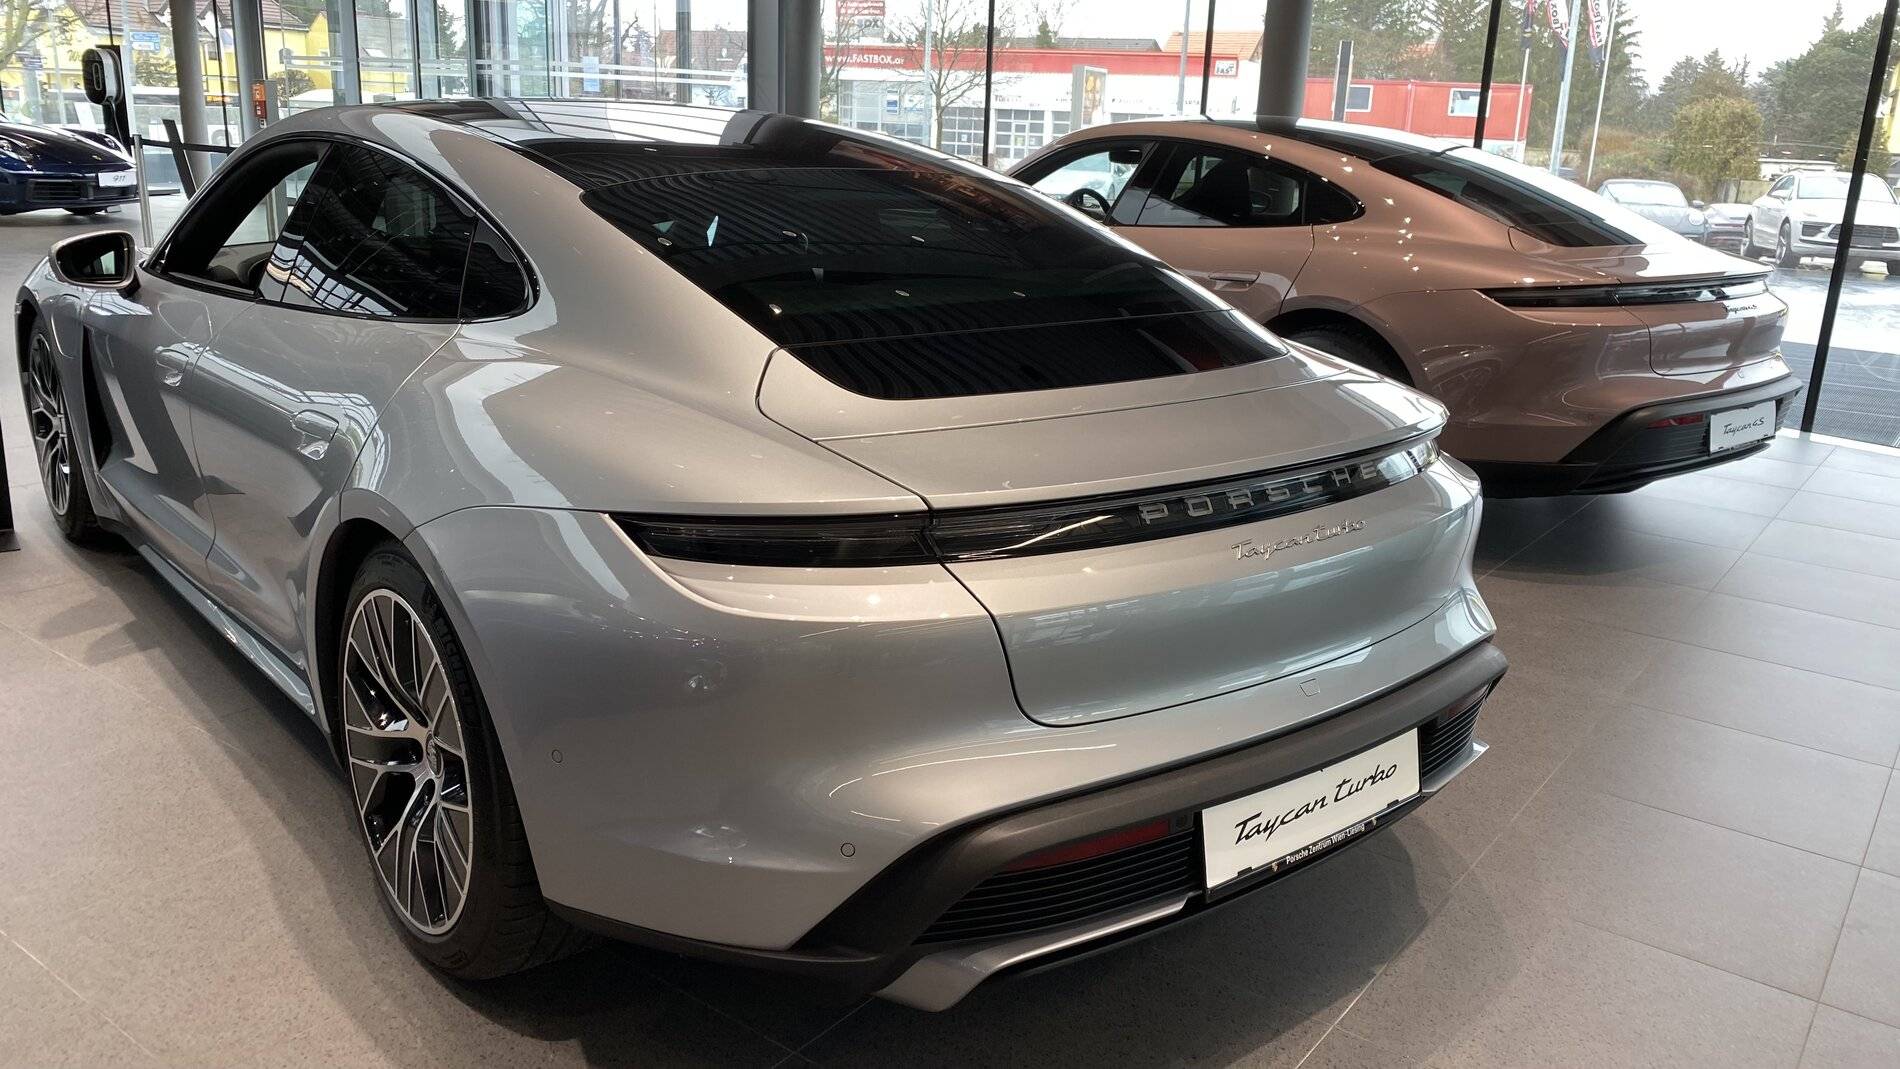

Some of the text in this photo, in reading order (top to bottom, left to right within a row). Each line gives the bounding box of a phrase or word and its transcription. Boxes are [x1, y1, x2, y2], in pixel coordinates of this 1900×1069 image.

[1723, 417, 1764, 437] Taycan 4S
[1138, 462, 1377, 524] PORSCHE
[1231, 535, 1312, 560] Taycan
[1234, 763, 1397, 845] Taycan turbo
[1286, 823, 1365, 865] Porsche Zentrum Wien-Liesing
